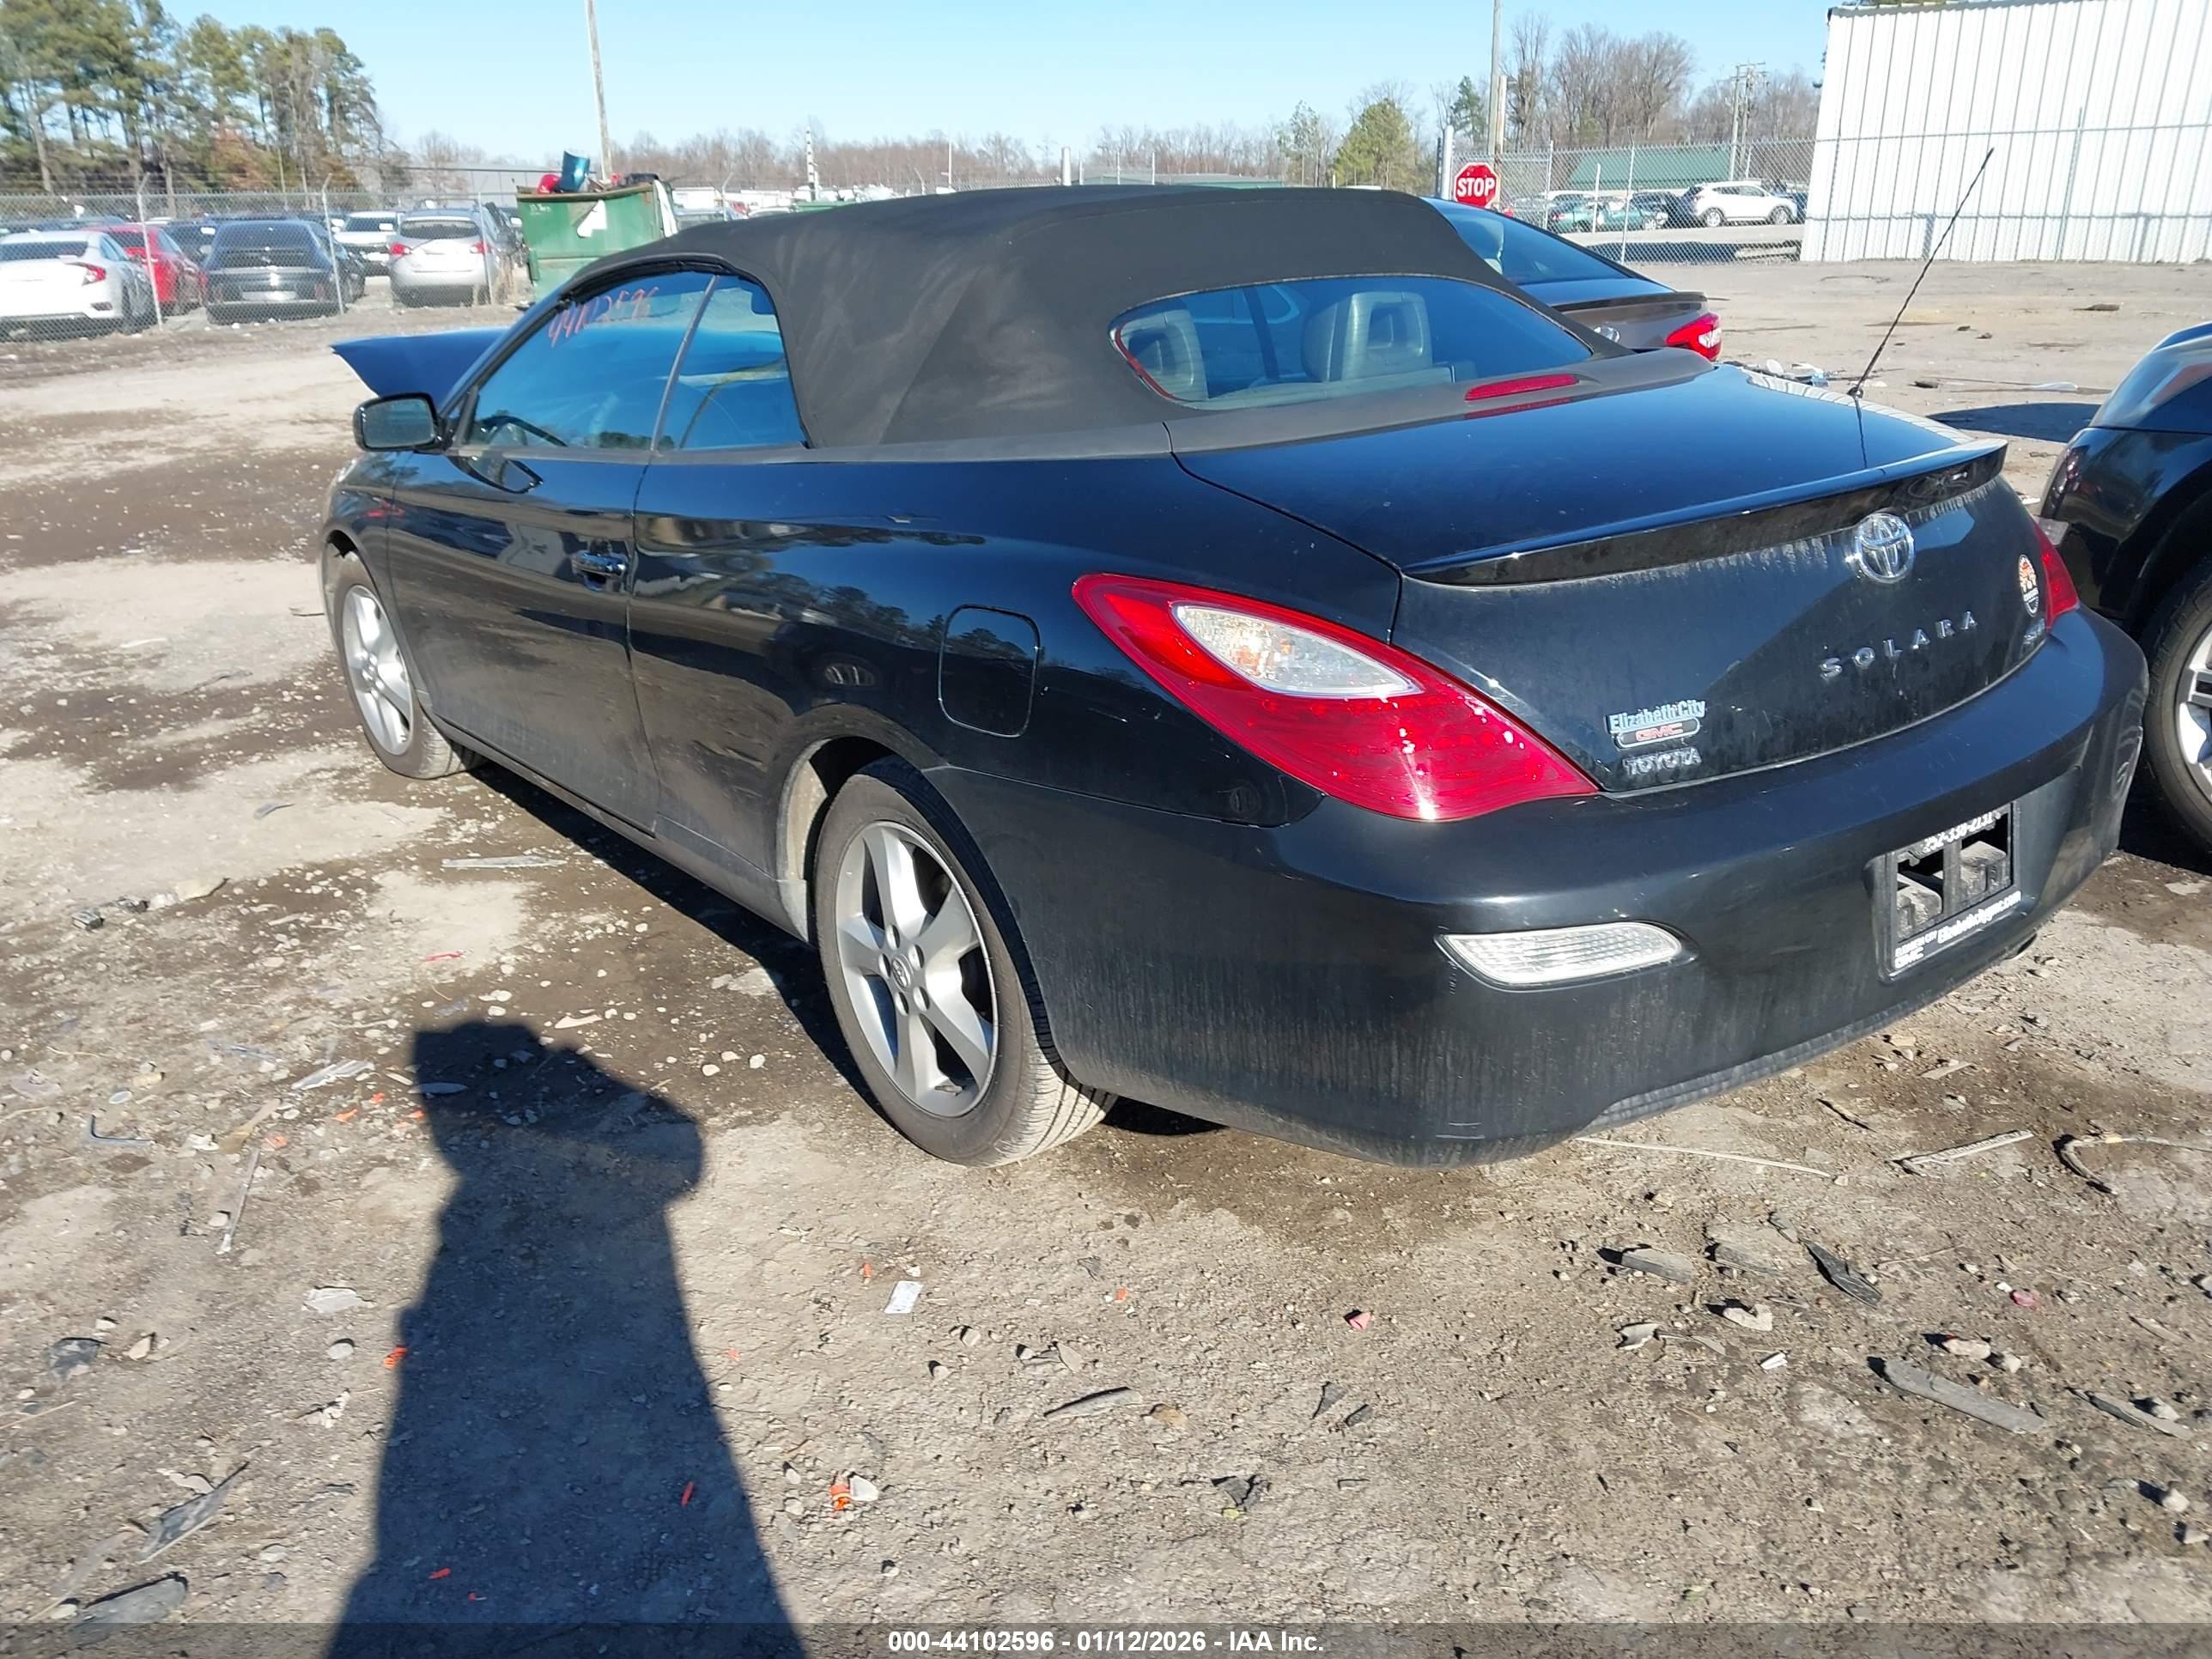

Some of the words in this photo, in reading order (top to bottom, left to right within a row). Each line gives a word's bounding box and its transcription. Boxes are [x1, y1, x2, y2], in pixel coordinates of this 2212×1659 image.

[1457, 177, 1495, 198] STOP
[1819, 611, 1978, 683] SOLARA
[1608, 703, 1680, 732] Elizabeth
[1677, 699, 1706, 718] City
[1635, 722, 1684, 742] GMC
[1621, 746, 1703, 775] TOYOTA
